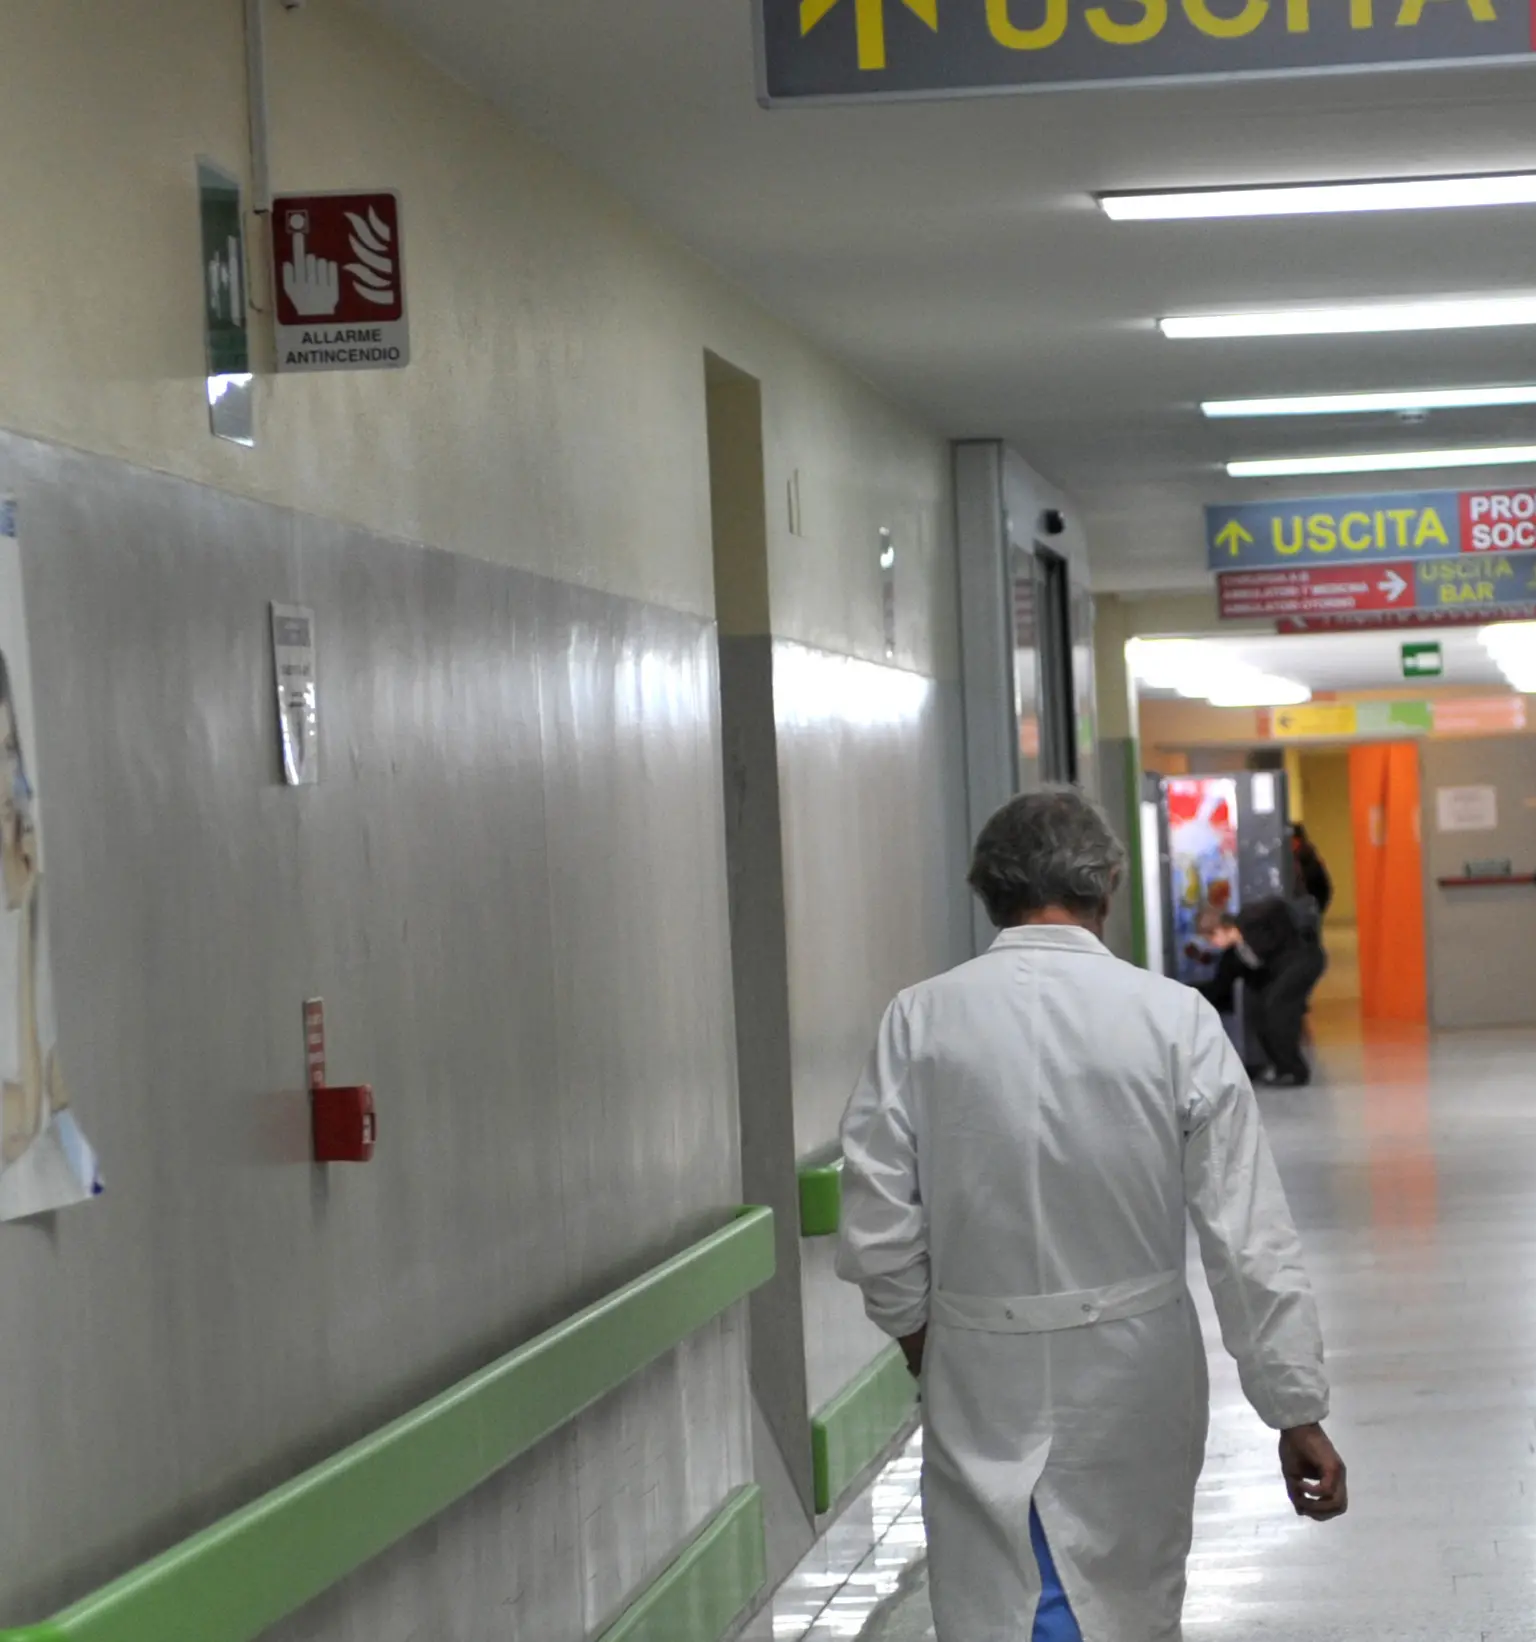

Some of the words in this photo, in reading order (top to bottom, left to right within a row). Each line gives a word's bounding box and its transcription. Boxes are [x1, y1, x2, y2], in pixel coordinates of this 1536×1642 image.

[301, 329, 381, 345] ALLARME
[285, 346, 400, 365] ANTINCENDIO
[1271, 507, 1449, 554] USCITA
[1419, 555, 1514, 583] USCITA
[1439, 580, 1494, 604] BAR
